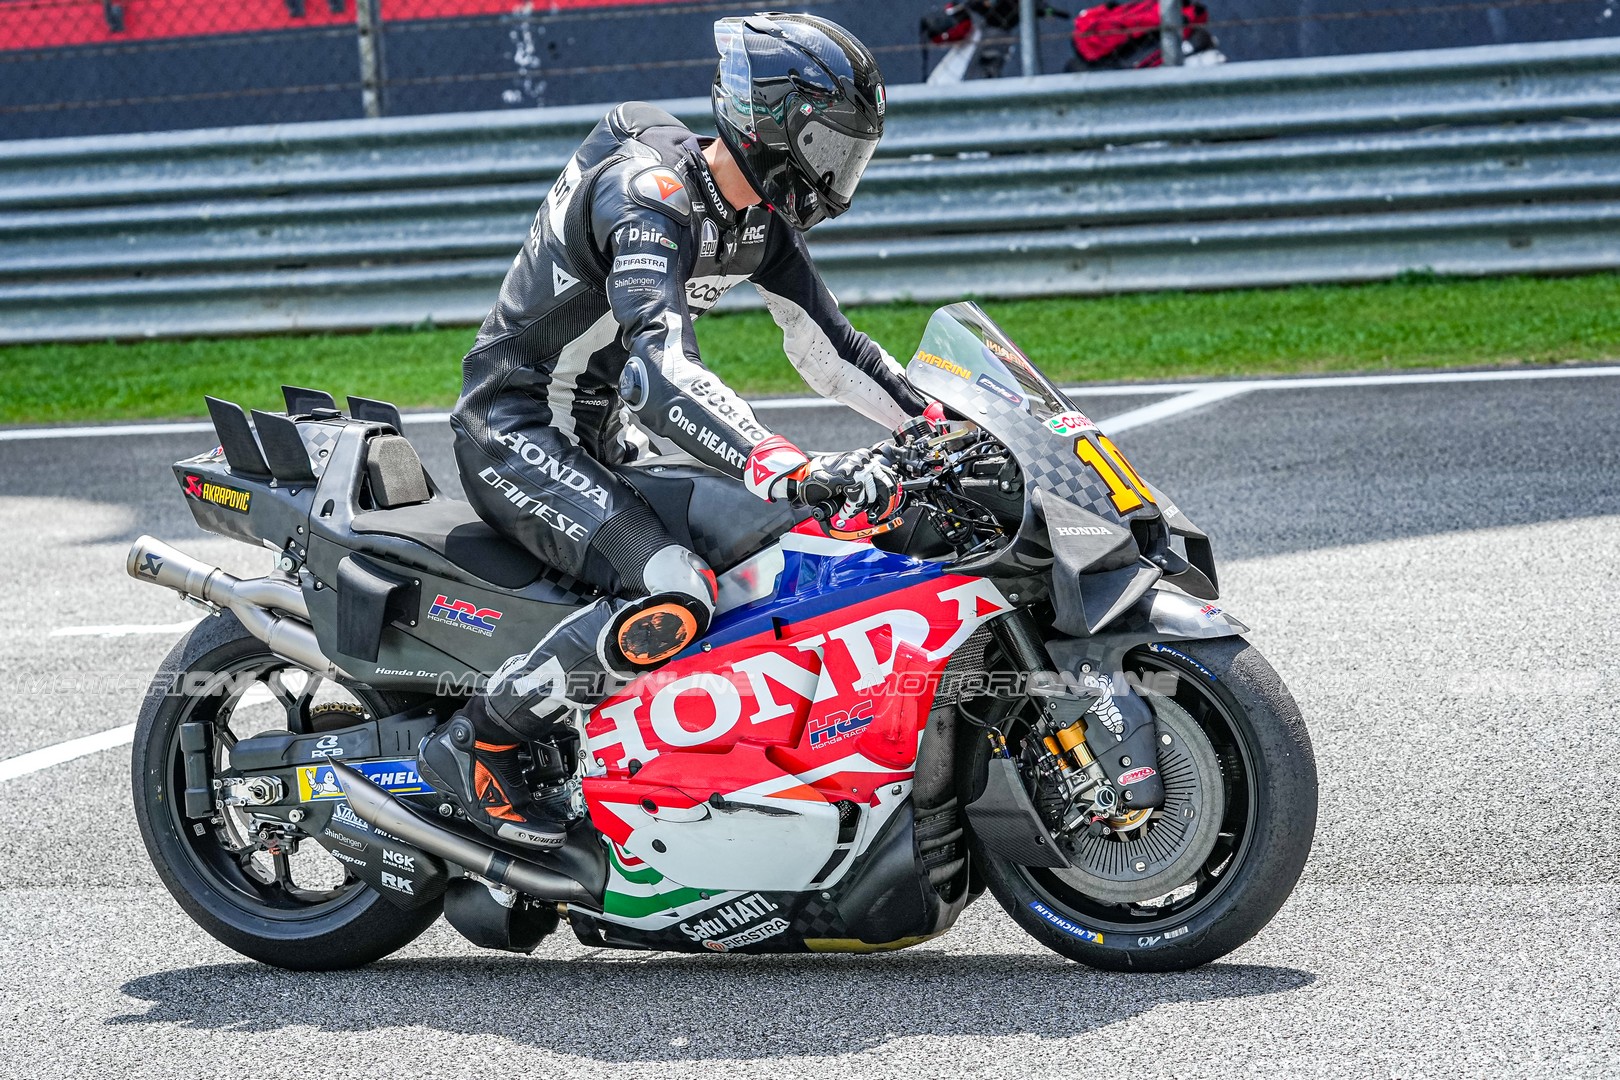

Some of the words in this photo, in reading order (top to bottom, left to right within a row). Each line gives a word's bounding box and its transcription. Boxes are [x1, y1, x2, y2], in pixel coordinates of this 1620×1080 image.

[702, 170, 729, 220] HONDA
[623, 258, 666, 268] FIFASTRA
[614, 277, 656, 289] ShinDengen
[917, 350, 973, 380] MARINI
[668, 405, 697, 436] One
[495, 432, 611, 509] HONDA
[477, 466, 590, 543] DAINESE
[1055, 526, 1113, 536] HONDA
[427, 594, 503, 632] HRC
[427, 614, 459, 628] Honda
[459, 624, 493, 638] RACING
[375, 667, 414, 677] Honda
[585, 577, 1018, 769] HONDA
[807, 699, 875, 746] HRC
[311, 748, 344, 759] RCB
[811, 736, 843, 751] Honda
[324, 827, 362, 848] ShinDengen
[382, 848, 415, 869] NGK
[381, 870, 414, 893] RK
[679, 917, 728, 942] Satu
[717, 892, 779, 929] HATI.
[1034, 904, 1085, 937] MICHELIN
[722, 918, 788, 948] FIFASTRA
